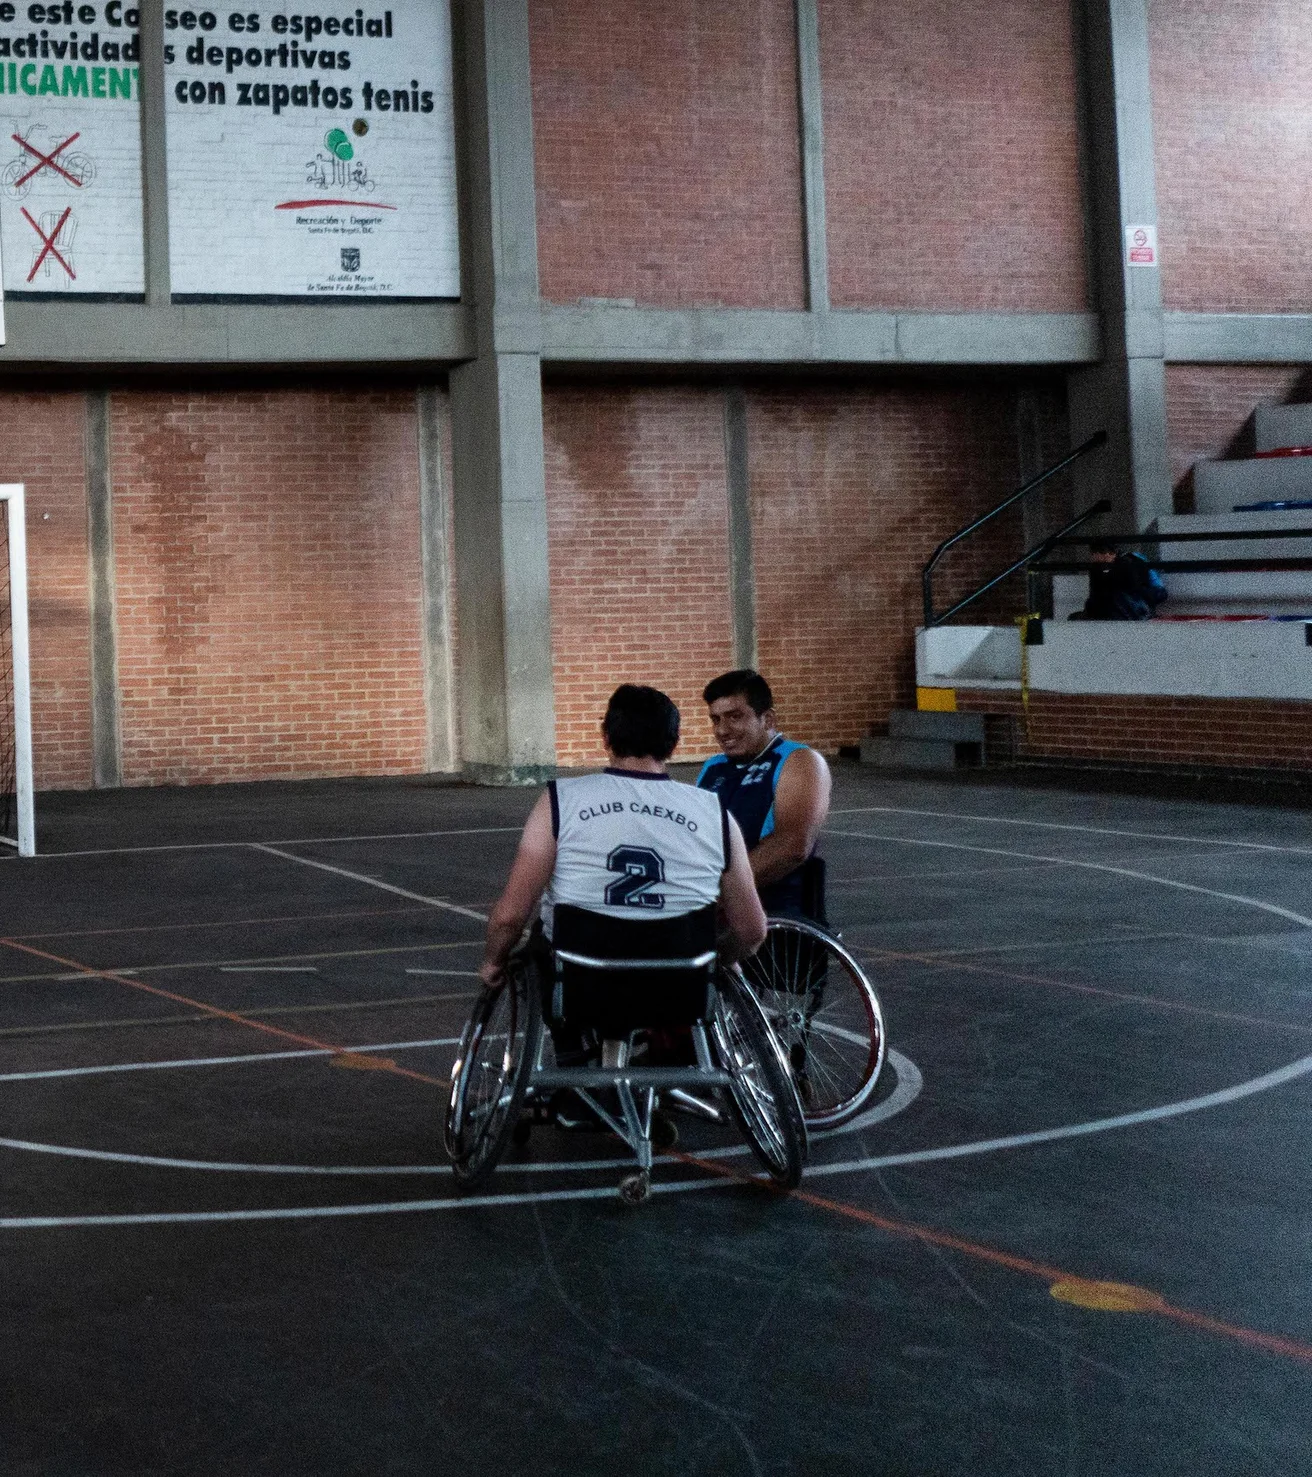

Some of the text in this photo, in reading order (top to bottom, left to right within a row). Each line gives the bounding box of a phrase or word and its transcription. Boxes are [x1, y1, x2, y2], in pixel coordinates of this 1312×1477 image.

[27, 0, 96, 25] este
[228, 12, 260, 33] es
[271, 9, 393, 42] especial
[186, 37, 351, 74] deportivas
[175, 80, 225, 105] con
[236, 79, 353, 115] zapatos
[362, 79, 434, 113] tenis
[350, 216, 382, 226] Deporte
[579, 802, 698, 832] CLUB CAEXBO
[604, 844, 666, 910] 2
